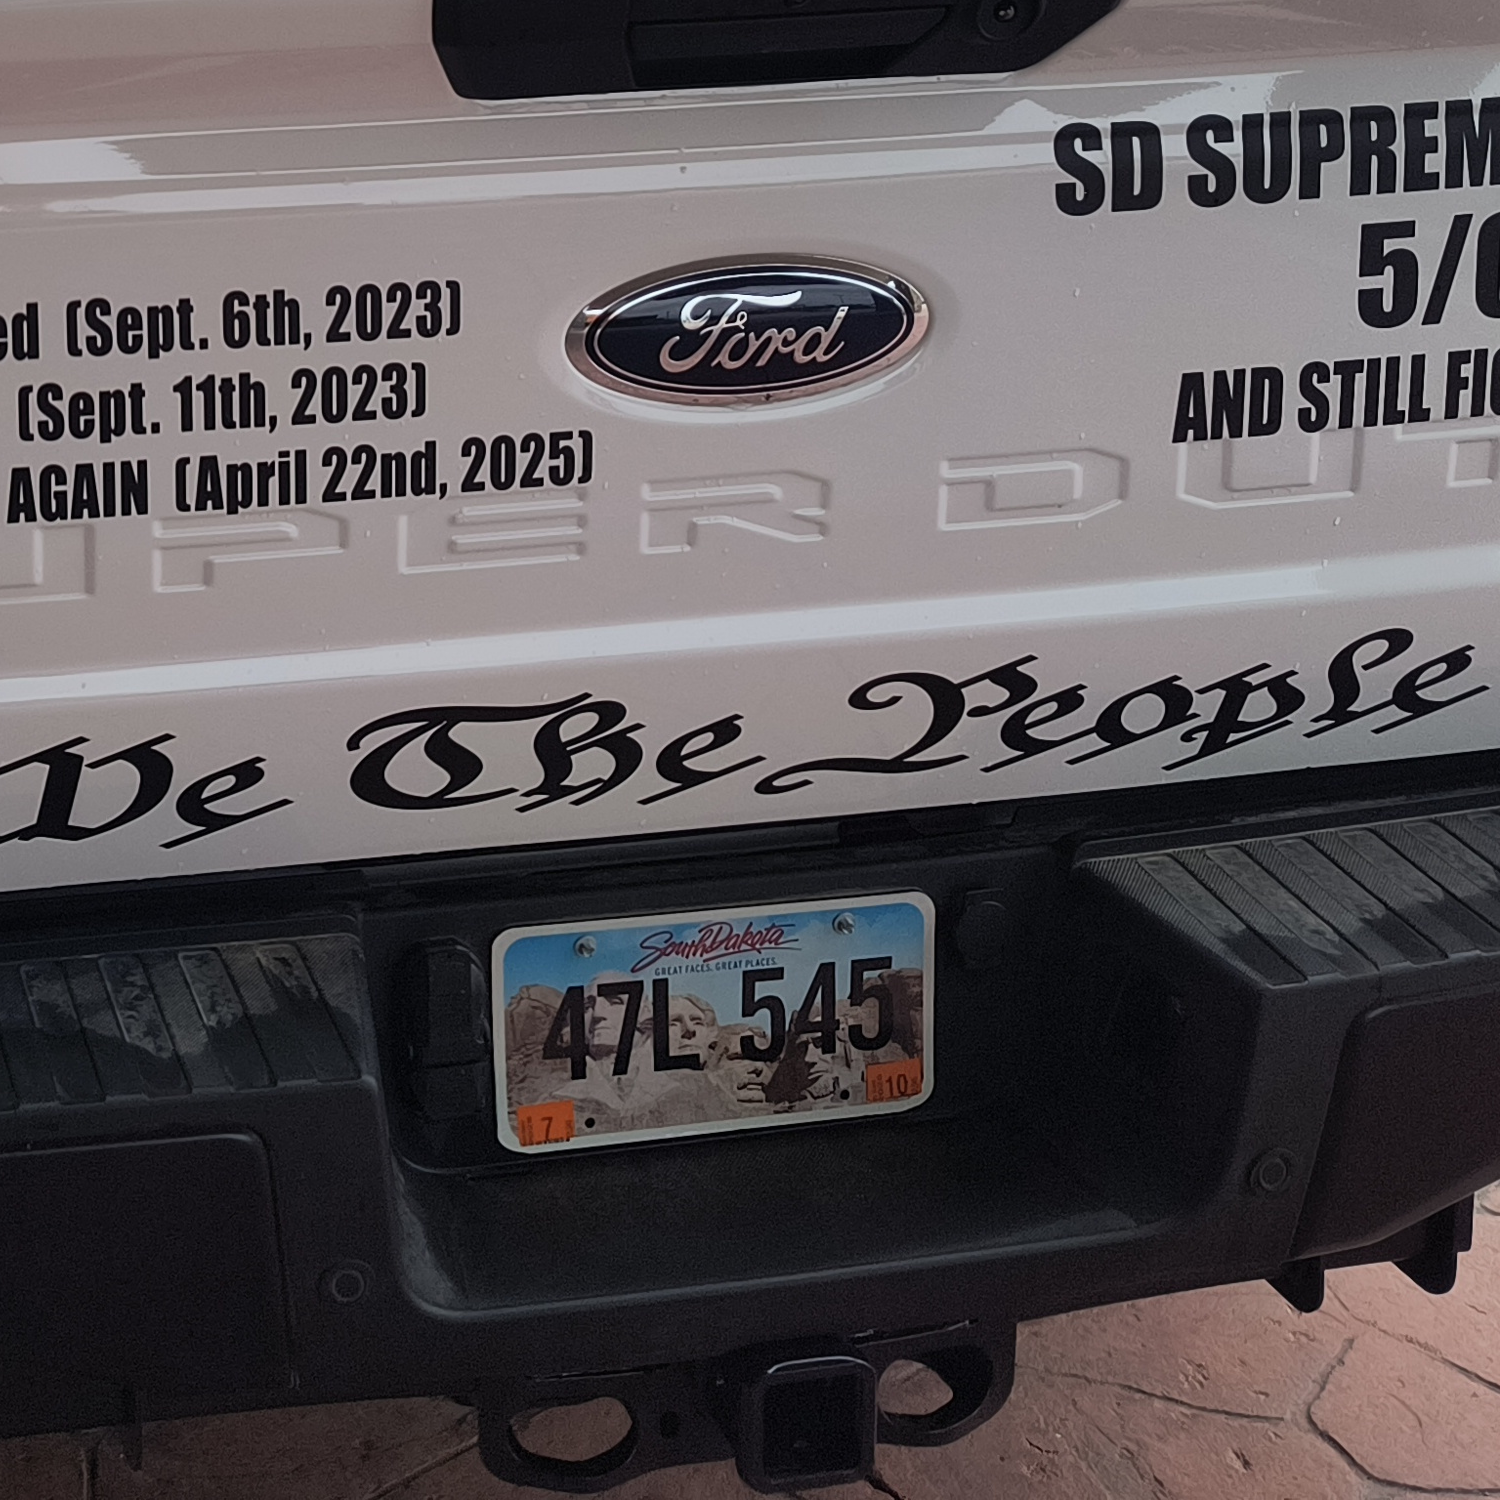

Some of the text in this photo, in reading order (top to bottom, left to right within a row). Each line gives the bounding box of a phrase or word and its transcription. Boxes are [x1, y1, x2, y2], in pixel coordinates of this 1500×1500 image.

[1053, 120, 1164, 216] SD
[66, 297, 210, 359] (Sept.
[221, 289, 312, 350] 6th,
[324, 279, 462, 343] 2023)
[658, 288, 850, 375] Ford
[17, 381, 161, 443] (Sept.
[172, 372, 278, 434] 11th,
[290, 362, 427, 425] 2023)
[1172, 348, 1500, 443] AND STILL FI
[6, 458, 149, 524] AGAIN
[174, 448, 308, 515] (April
[321, 441, 448, 503] 22nd,
[460, 429, 594, 492] 2025)
[346, 691, 768, 814] The
[754, 627, 1491, 795] People
[630, 921, 800, 974] South Dakota
[654, 965, 683, 977] GREAT
[715, 960, 742, 971] GREAT
[744, 957, 778, 969] PLACES.
[541, 956, 894, 1081] 47L 545
[885, 1073, 909, 1097] 10
[540, 1116, 554, 1140] 7
